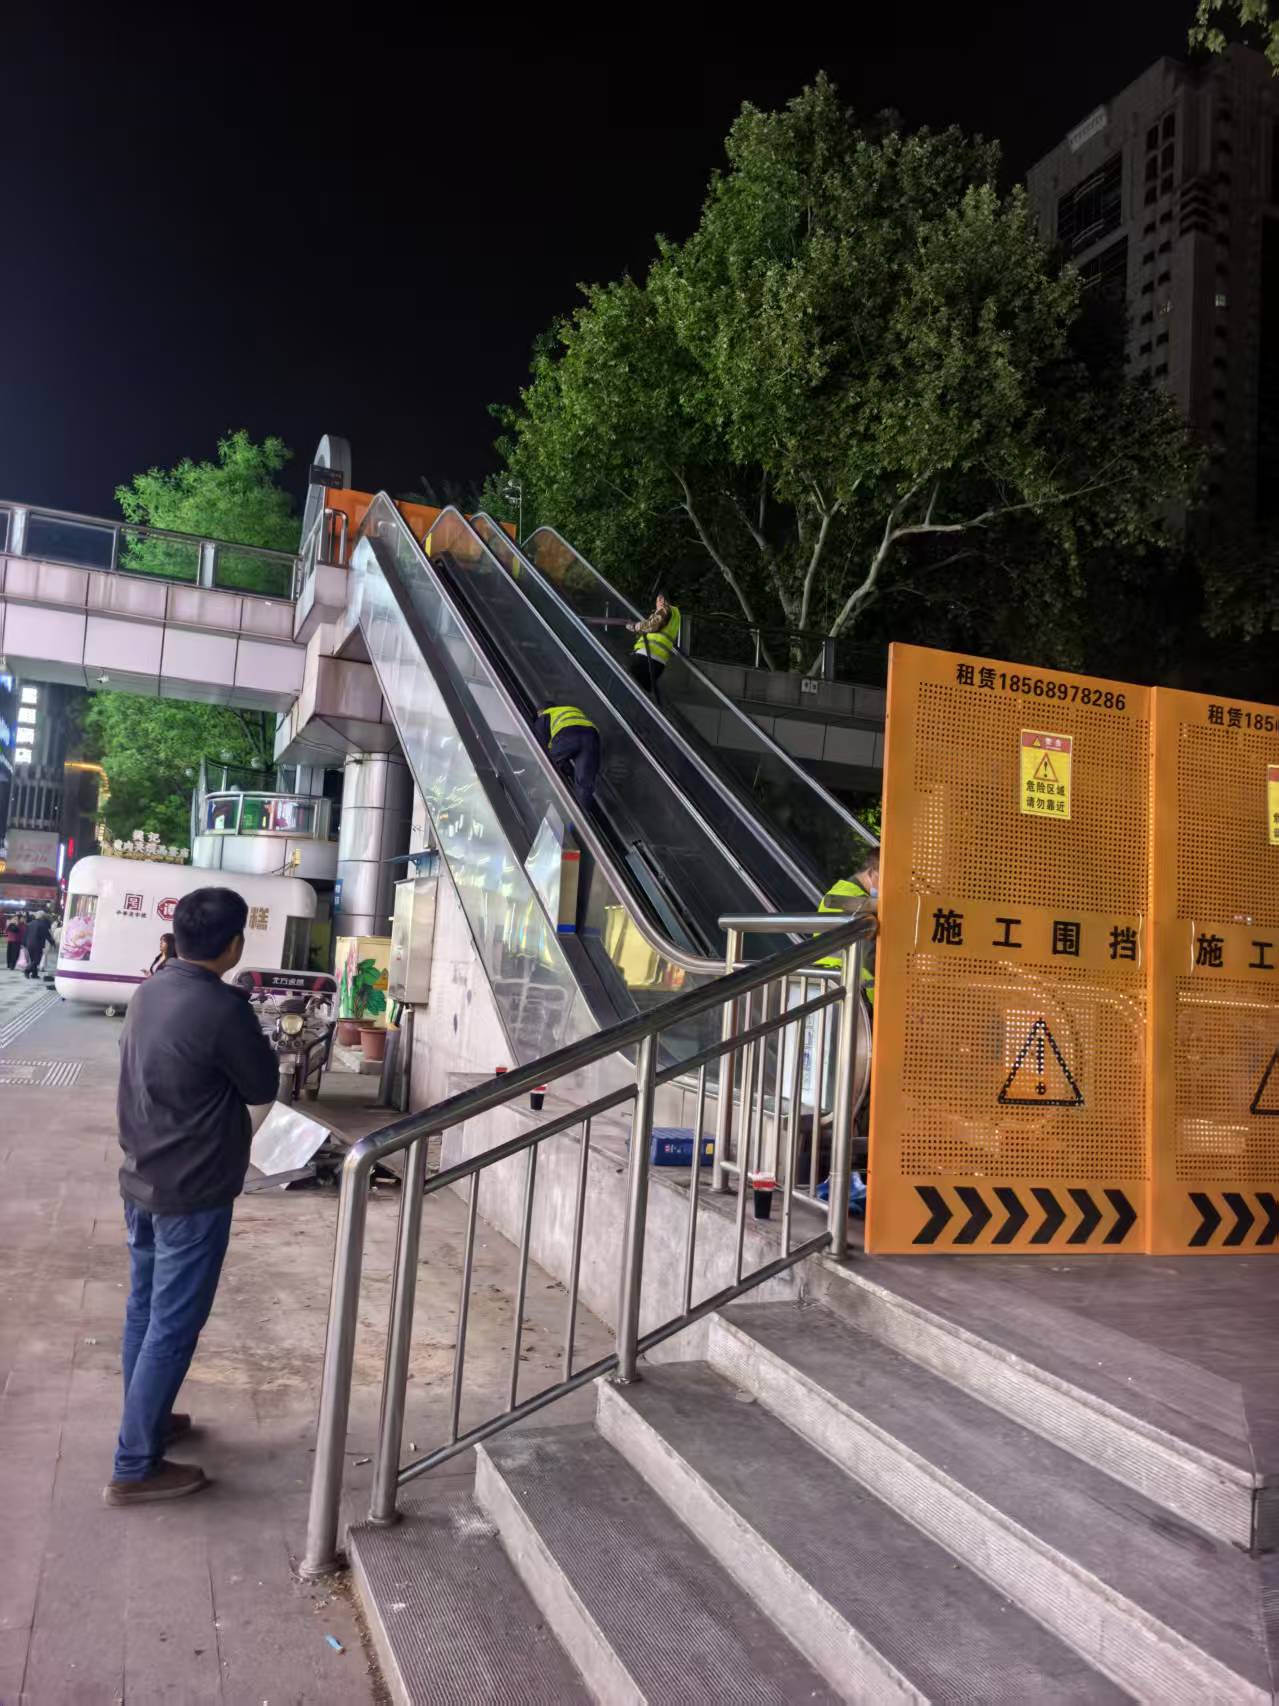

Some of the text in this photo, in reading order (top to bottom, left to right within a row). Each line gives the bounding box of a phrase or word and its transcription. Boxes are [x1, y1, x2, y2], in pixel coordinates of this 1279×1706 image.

[956, 663, 1126, 710] 租赁18568978286
[1208, 704, 1279, 732] 租赁185
[1026, 780, 1065, 796] 危险区域
[1026, 796, 1065, 812] 请勿靠近
[931, 907, 1137, 961] 施工围挡
[1196, 933, 1275, 970] 施工
